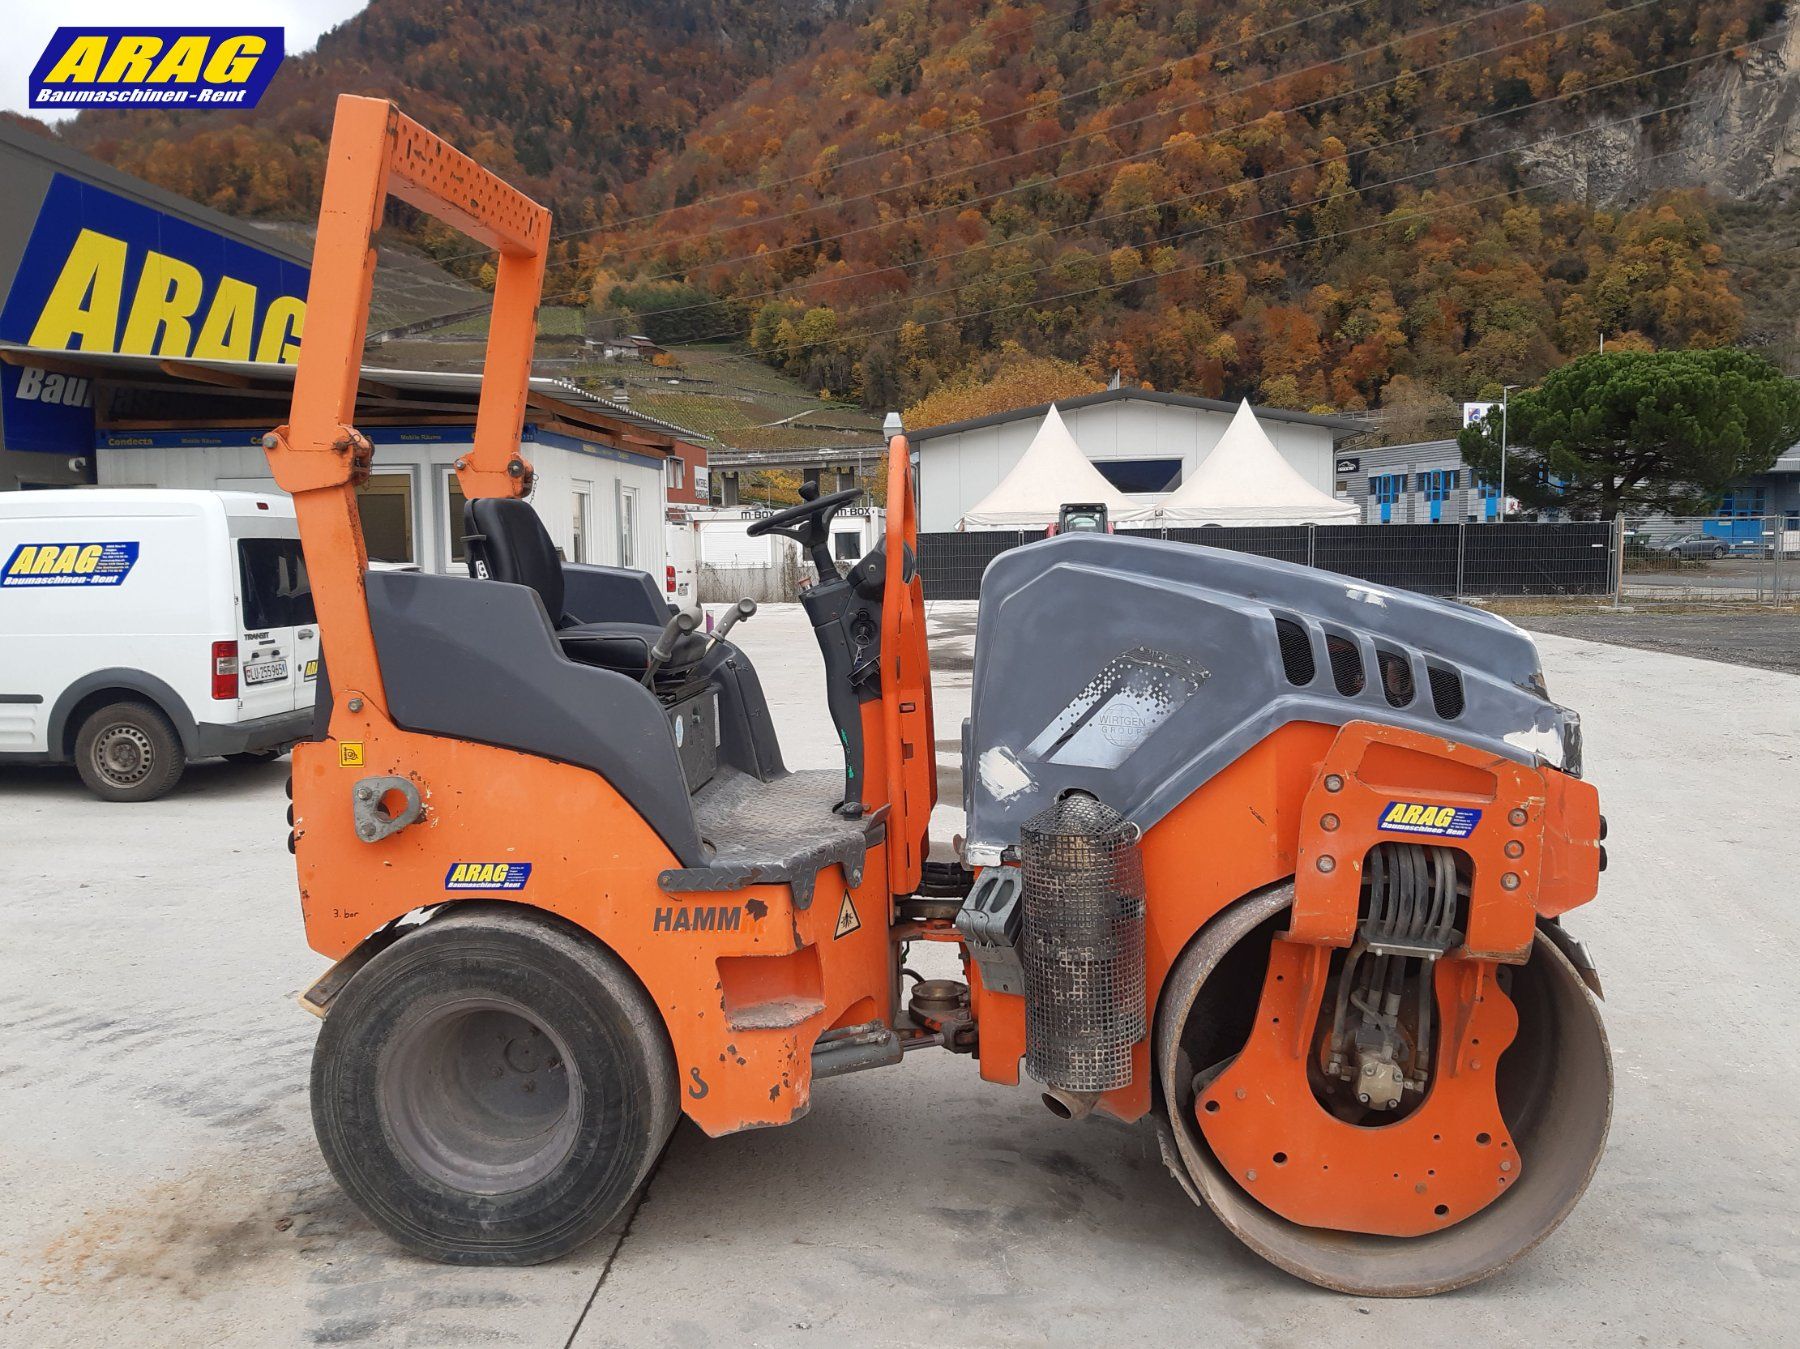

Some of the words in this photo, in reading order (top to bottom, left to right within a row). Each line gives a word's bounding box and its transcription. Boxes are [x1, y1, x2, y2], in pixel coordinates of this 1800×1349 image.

[27, 227, 308, 366] ARAG
[8, 544, 103, 575] ARAG
[244, 632, 270, 640] TRANSIT
[1099, 715, 1146, 727] WIRTGEN
[1101, 726, 1142, 735] GROUP
[1384, 803, 1456, 828] ARAG
[449, 863, 509, 882] ARAG
[653, 906, 741, 932] HAMM
